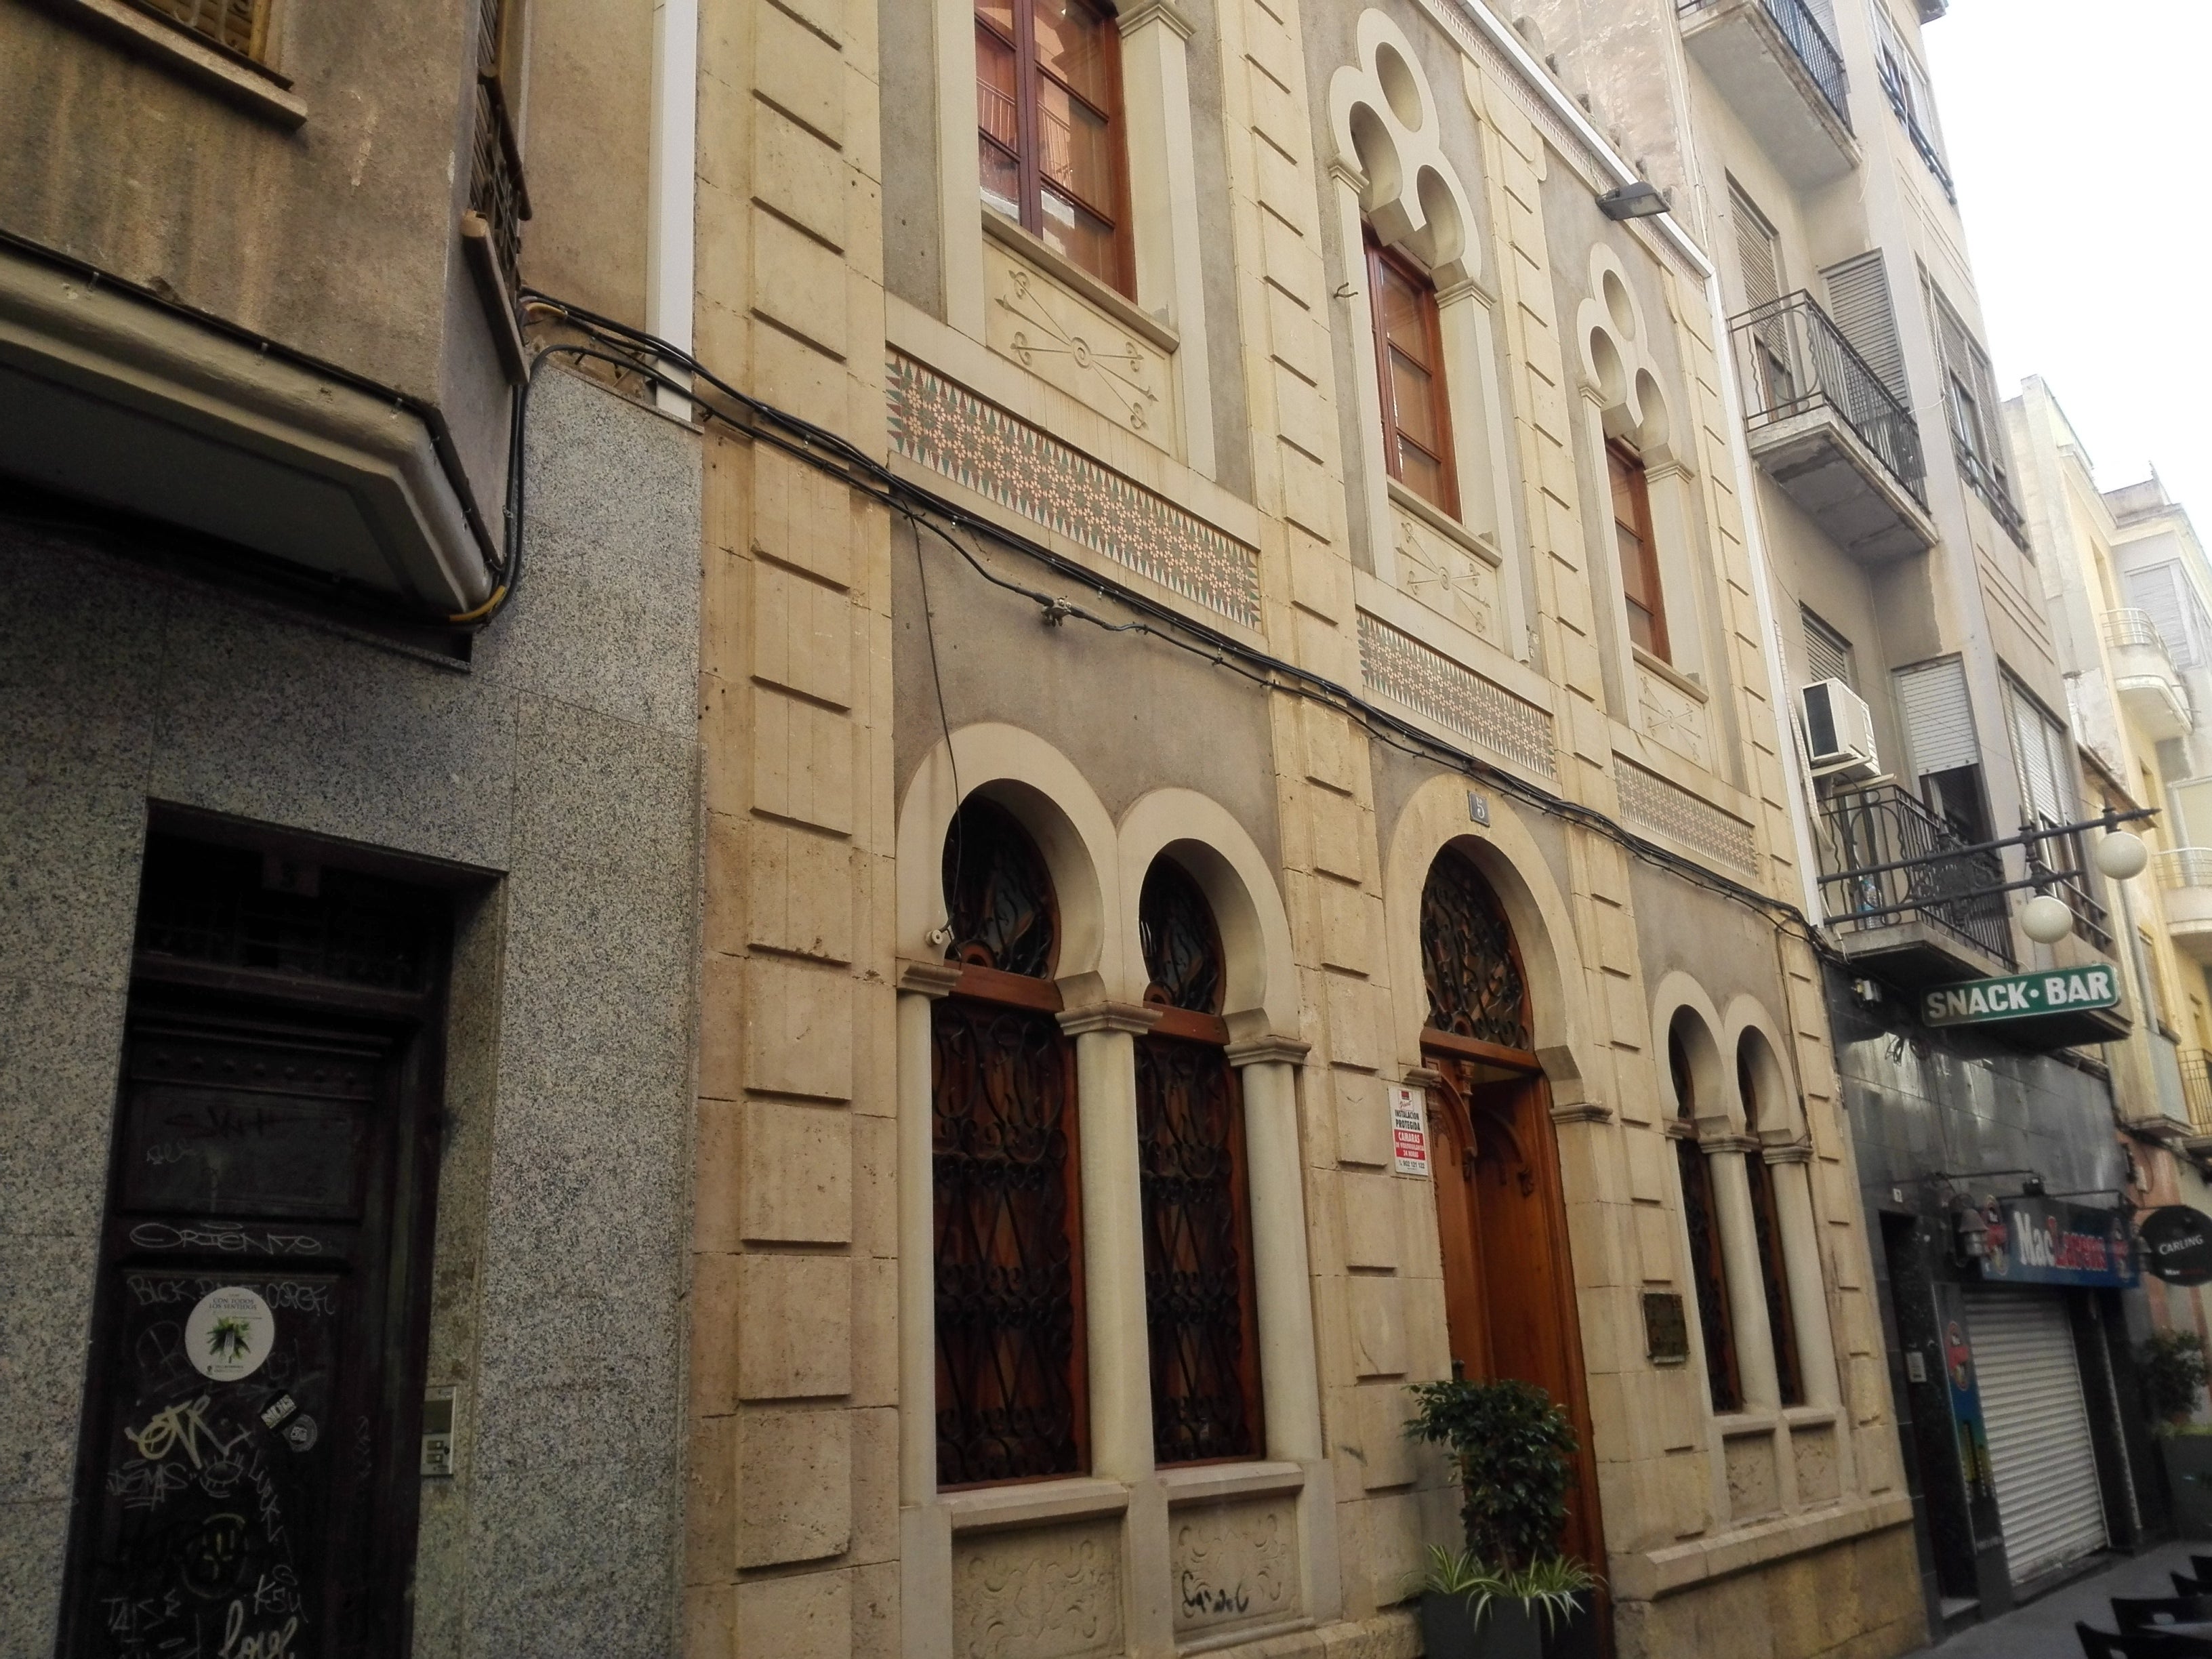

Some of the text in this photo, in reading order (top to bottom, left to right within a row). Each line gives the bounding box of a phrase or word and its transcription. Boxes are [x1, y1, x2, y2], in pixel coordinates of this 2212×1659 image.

[1475, 796, 1486, 819] 5
[1395, 1119, 1420, 1131] PROTEGIDA
[1398, 1131, 1420, 1144] CAMARAS
[2158, 1234, 2205, 1256] CARLING
